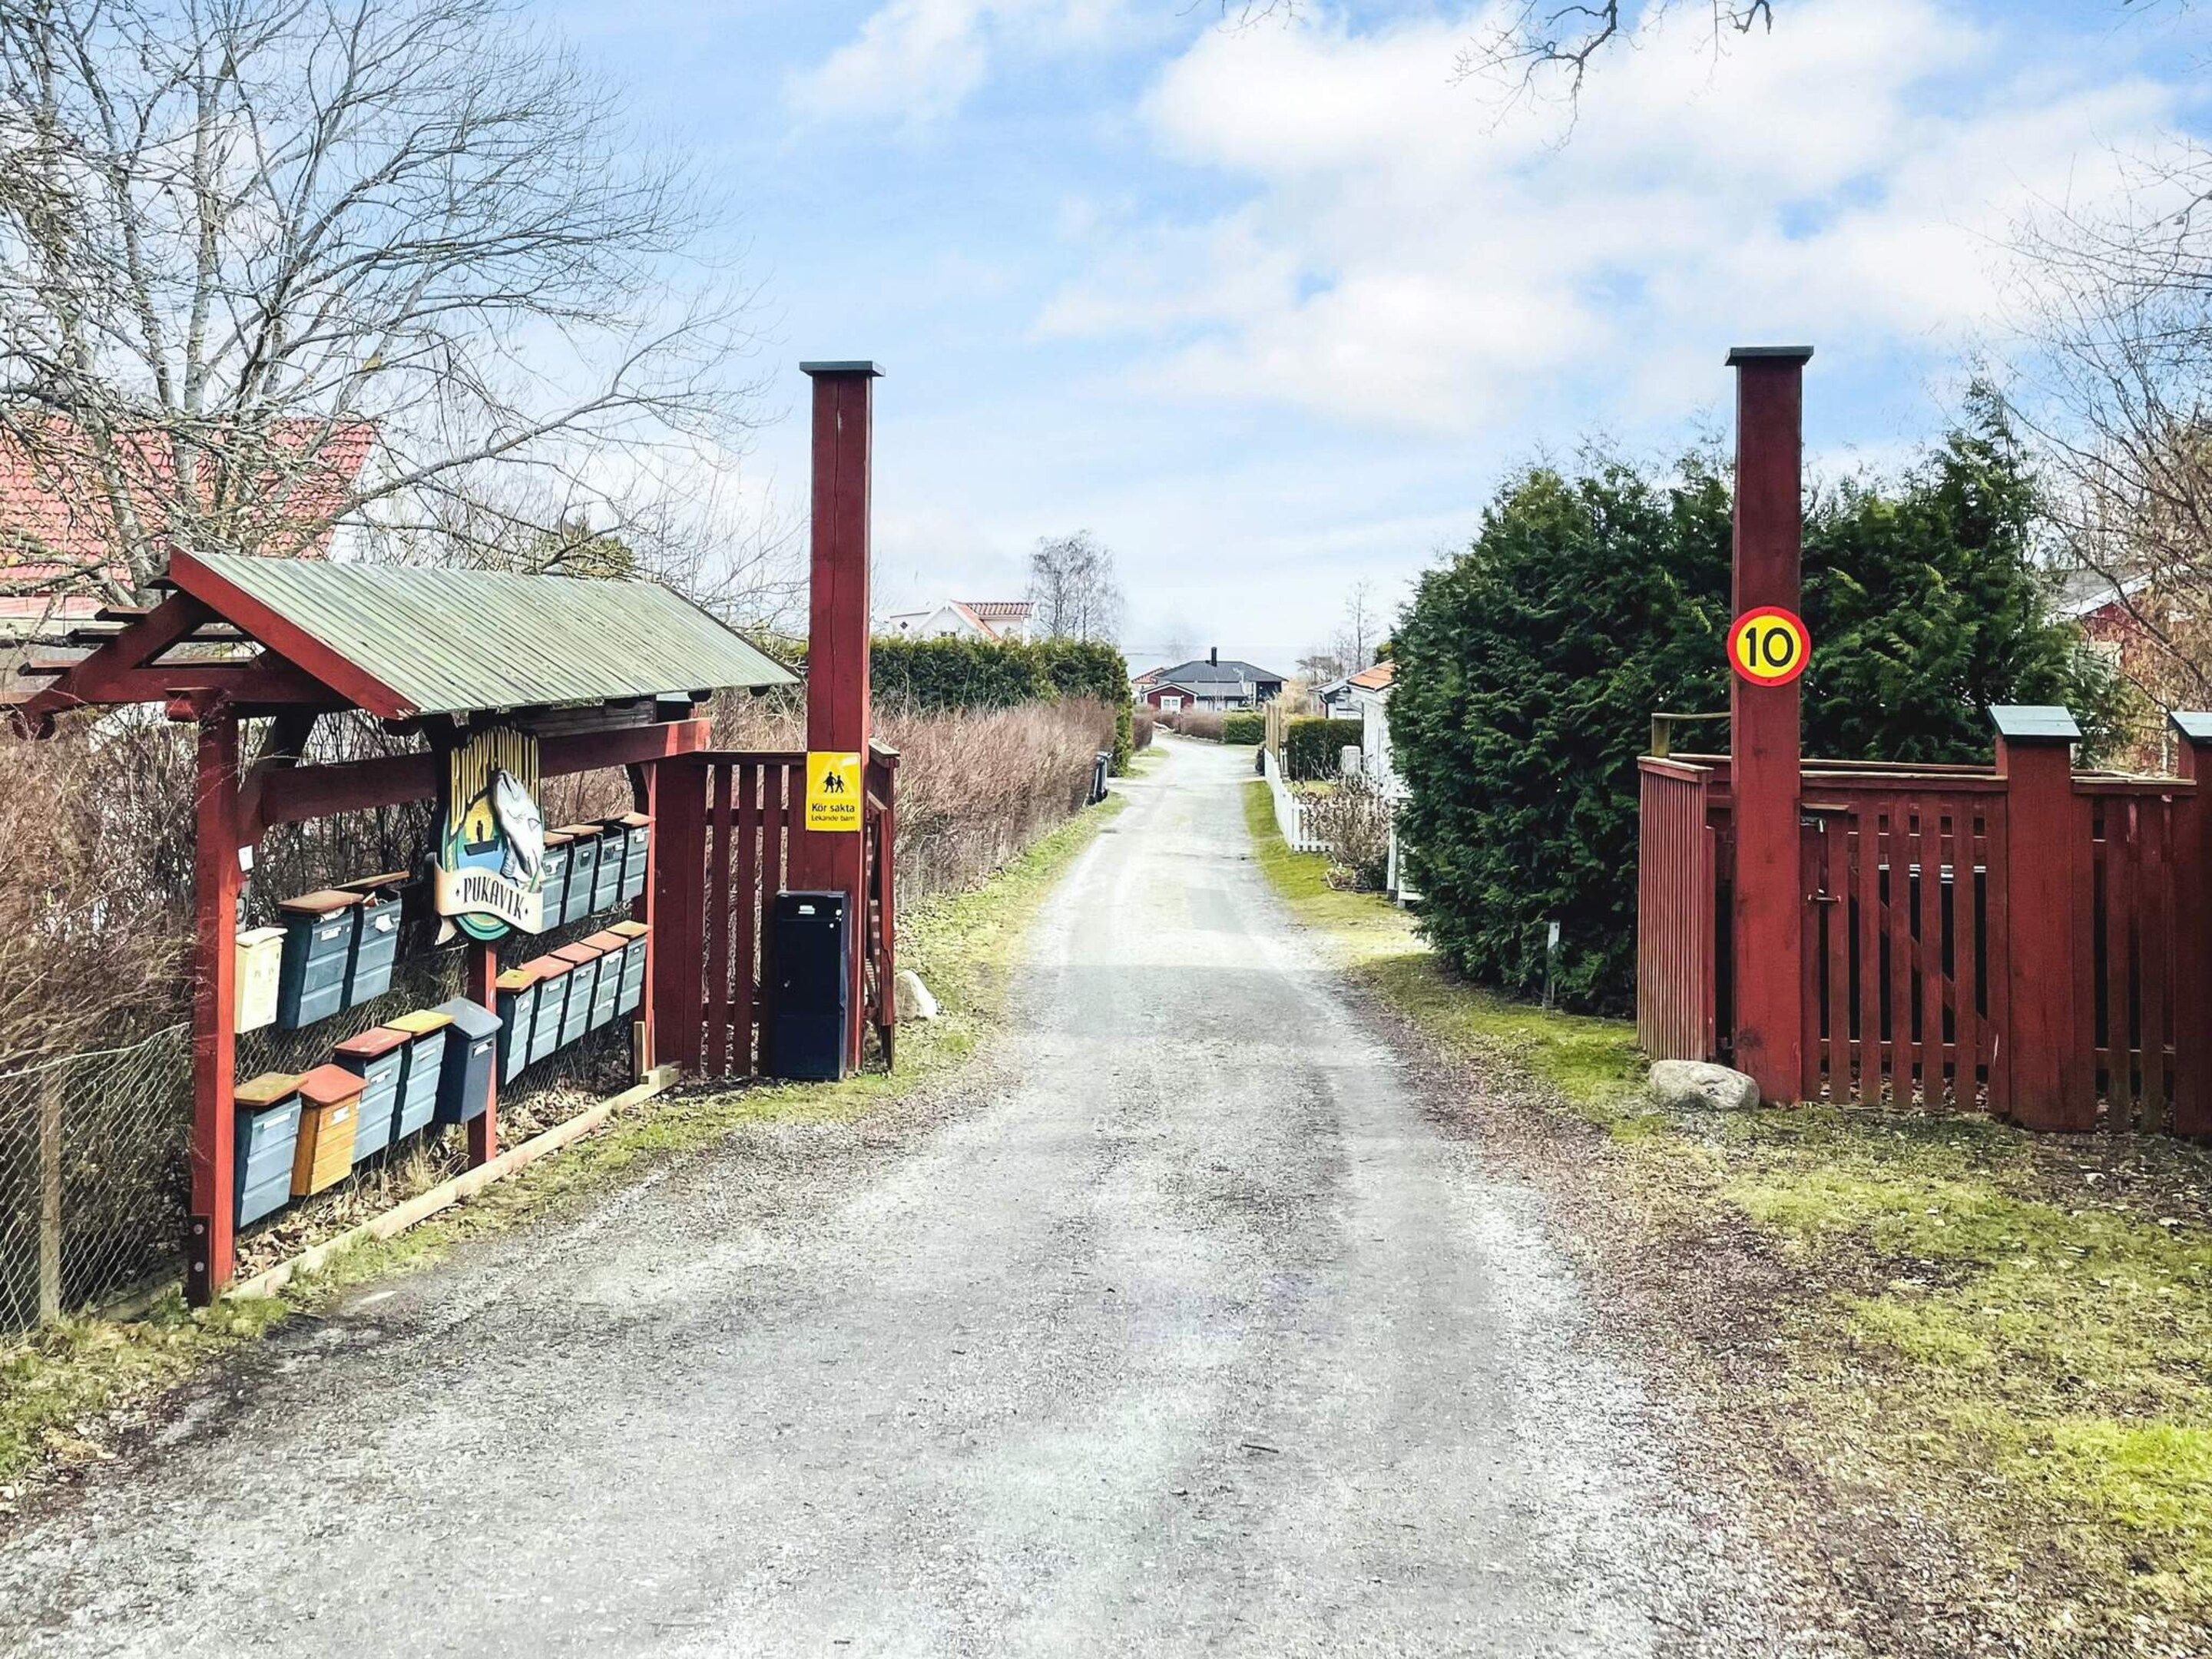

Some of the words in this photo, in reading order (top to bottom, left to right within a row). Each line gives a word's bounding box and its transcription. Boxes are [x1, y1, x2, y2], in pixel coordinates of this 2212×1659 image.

[1745, 628, 1793, 667] 10
[811, 803, 826, 812] Kör
[830, 803, 855, 813] sakta
[463, 876, 524, 920] PUKAVIK
